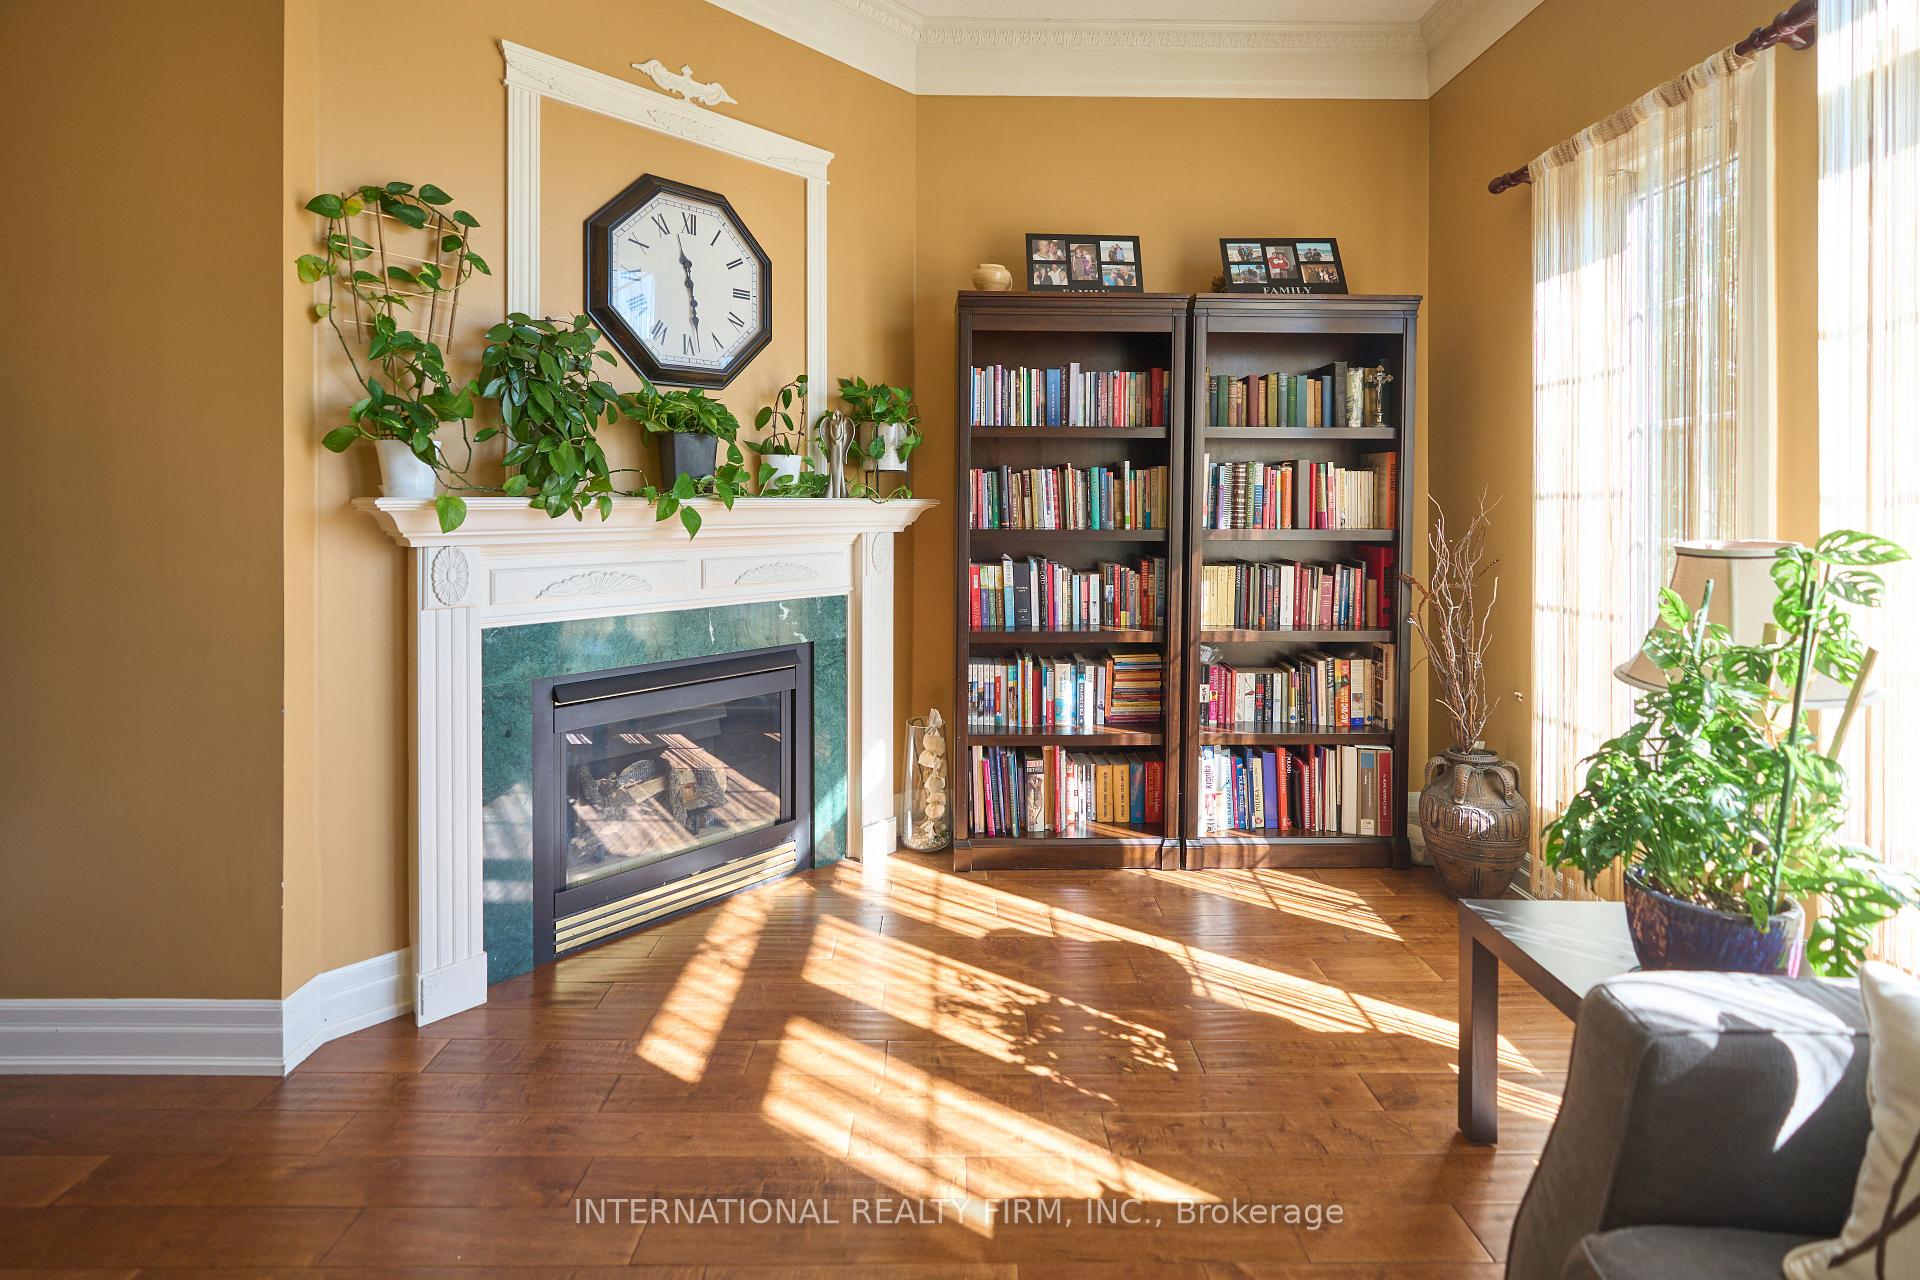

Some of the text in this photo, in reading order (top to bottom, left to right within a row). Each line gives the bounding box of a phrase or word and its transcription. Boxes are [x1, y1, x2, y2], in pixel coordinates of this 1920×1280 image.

[651, 213, 671, 238] XI
[681, 212, 697, 236] XII
[628, 231, 650, 255] X
[710, 230, 721, 247] I
[726, 258, 744, 270] II
[732, 288, 751, 301] III
[1263, 287, 1312, 295] FAMILY
[651, 319, 668, 346] VII
[726, 311, 745, 333] IV
[682, 333, 695, 356] VI
[711, 332, 724, 352] V
[1204, 765, 1213, 788] Kronika
